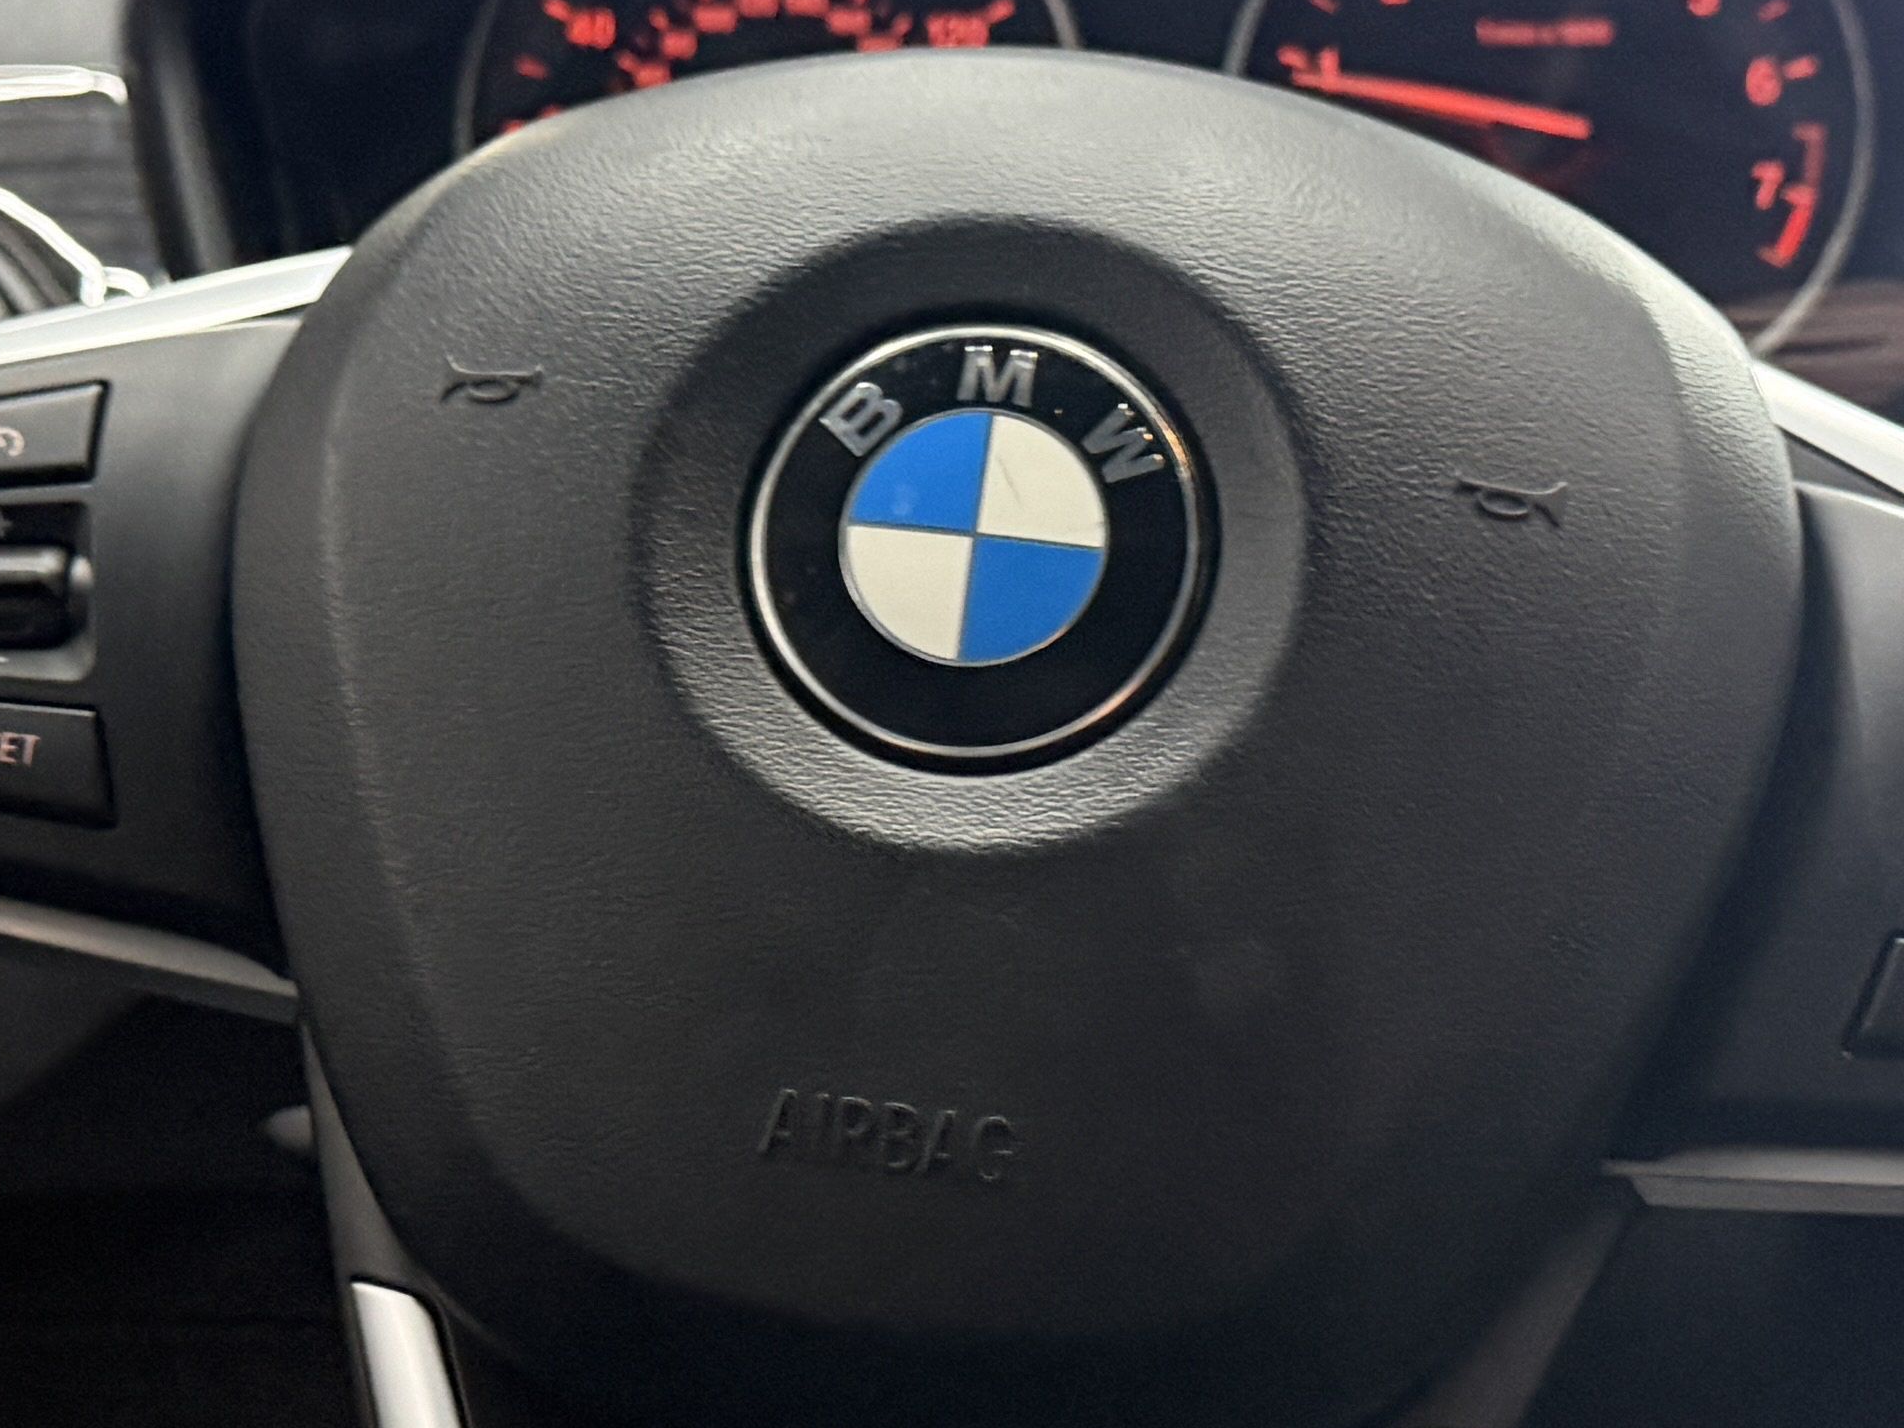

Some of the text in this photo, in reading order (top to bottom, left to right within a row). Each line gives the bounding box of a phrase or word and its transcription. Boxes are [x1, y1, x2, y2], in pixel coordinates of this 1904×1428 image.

[1752, 159, 1786, 211] 7
[818, 344, 1165, 484] BMW
[758, 1088, 1014, 1182] AIRBAG
